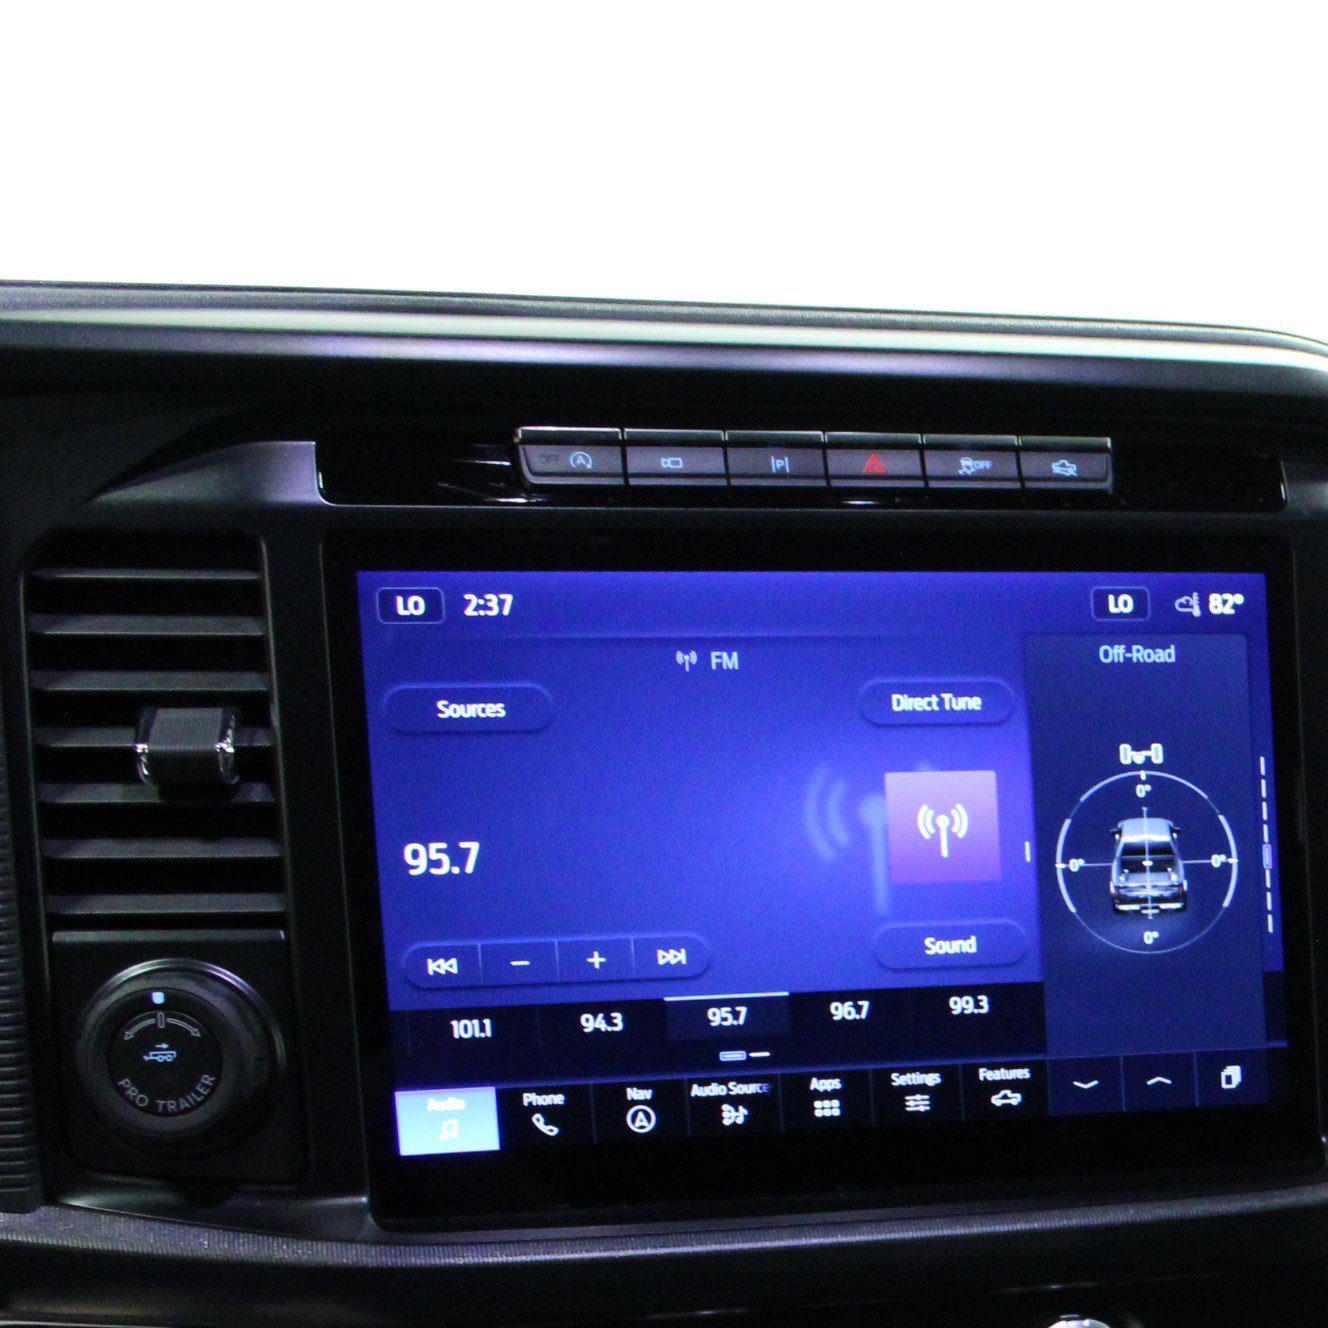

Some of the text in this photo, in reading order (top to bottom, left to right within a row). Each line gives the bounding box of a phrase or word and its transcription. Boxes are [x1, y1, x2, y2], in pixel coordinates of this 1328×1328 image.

[397, 596, 426, 616] LO
[464, 594, 514, 617] 2:37
[1108, 594, 1134, 614] LO
[711, 652, 739, 670] FM
[1099, 645, 1176, 664] Off-Road
[437, 700, 507, 719] Sources
[892, 693, 983, 712] Direct Tune
[404, 842, 480, 876] 95.7
[924, 936, 978, 956] Sound
[830, 1001, 870, 1021] 96.7
[949, 995, 990, 1015] 99.3
[581, 1012, 624, 1033] 94.3
[708, 1006, 748, 1027] 95.7
[451, 1019, 492, 1039] 101.1
[891, 1072, 942, 1087] Settings
[979, 1068, 1031, 1082] Features
[118, 1074, 216, 1112] PRO TRAILER
[626, 1088, 653, 1101] Nav
[691, 1083, 728, 1098] Audio
[810, 1078, 842, 1093] Apps
[426, 1096, 467, 1113] Audio
[523, 1093, 565, 1107] Phone
